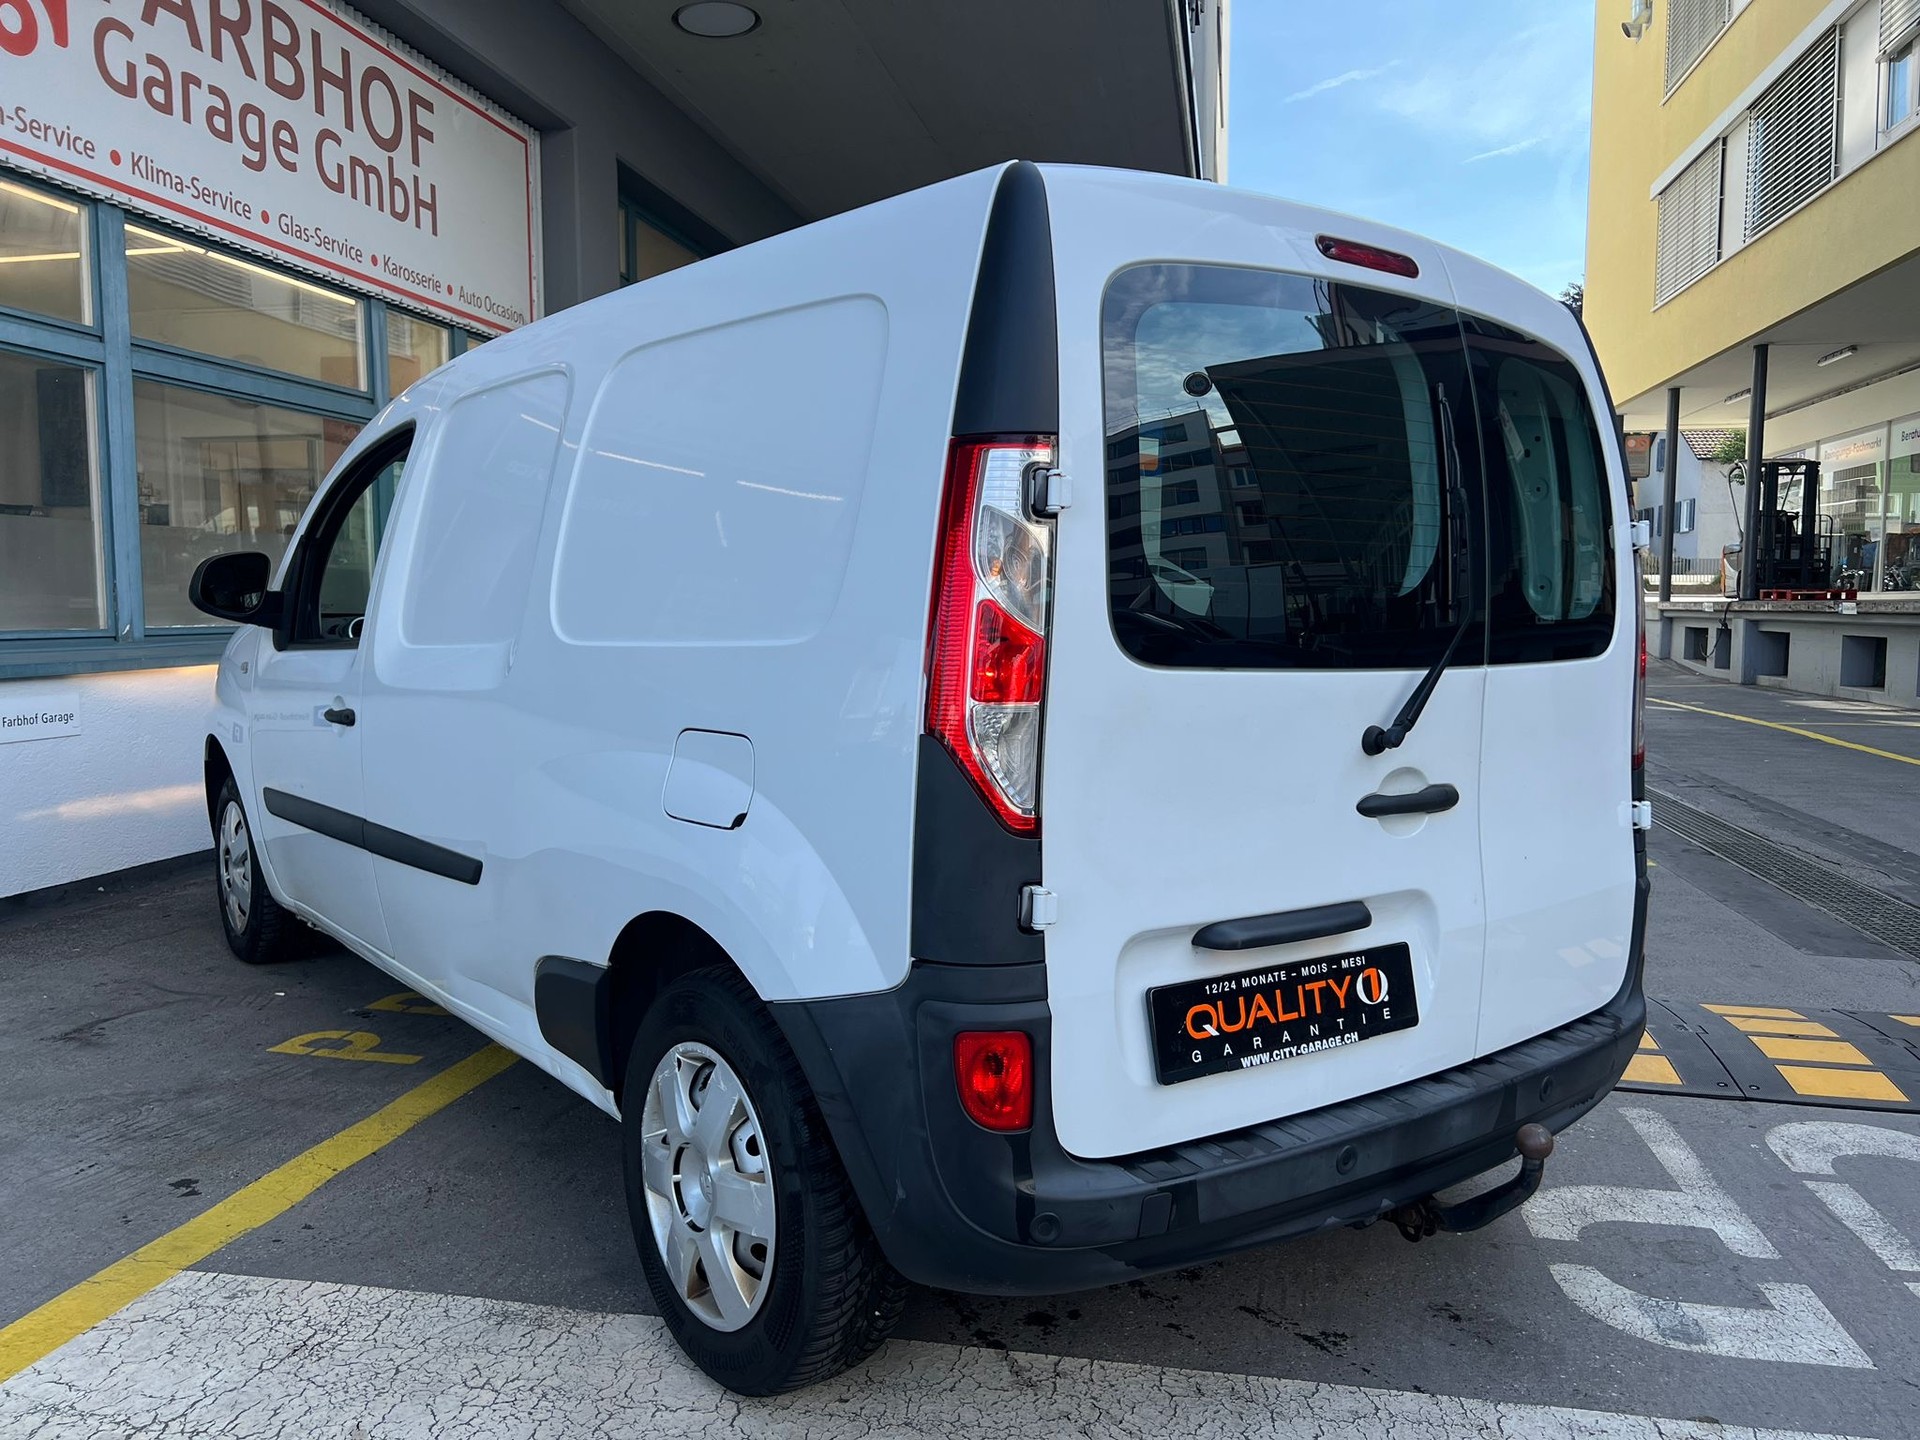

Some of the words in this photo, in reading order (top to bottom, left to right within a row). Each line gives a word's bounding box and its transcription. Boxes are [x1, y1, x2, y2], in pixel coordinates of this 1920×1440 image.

[93, 16, 299, 173] Garage
[315, 128, 438, 237] GmbH
[131, 151, 252, 220] Klima-Service
[278, 212, 363, 263] Glas-Service
[383, 254, 442, 293] Karosserie
[458, 285, 482, 309] Auto
[484, 295, 525, 325] Occasion
[2, 713, 38, 728] Farbhof
[41, 712, 74, 724] Garage
[1205, 980, 1237, 995] 12/24
[1241, 970, 1287, 988] MONATE
[1301, 963, 1328, 977] MOIS
[1341, 955, 1366, 969] MESI
[1185, 975, 1352, 1040] QUALITY
[1191, 1007, 1391, 1063] GARANTIE
[1240, 1031, 1359, 1068] WWW.CITY-GARAGE.CH
